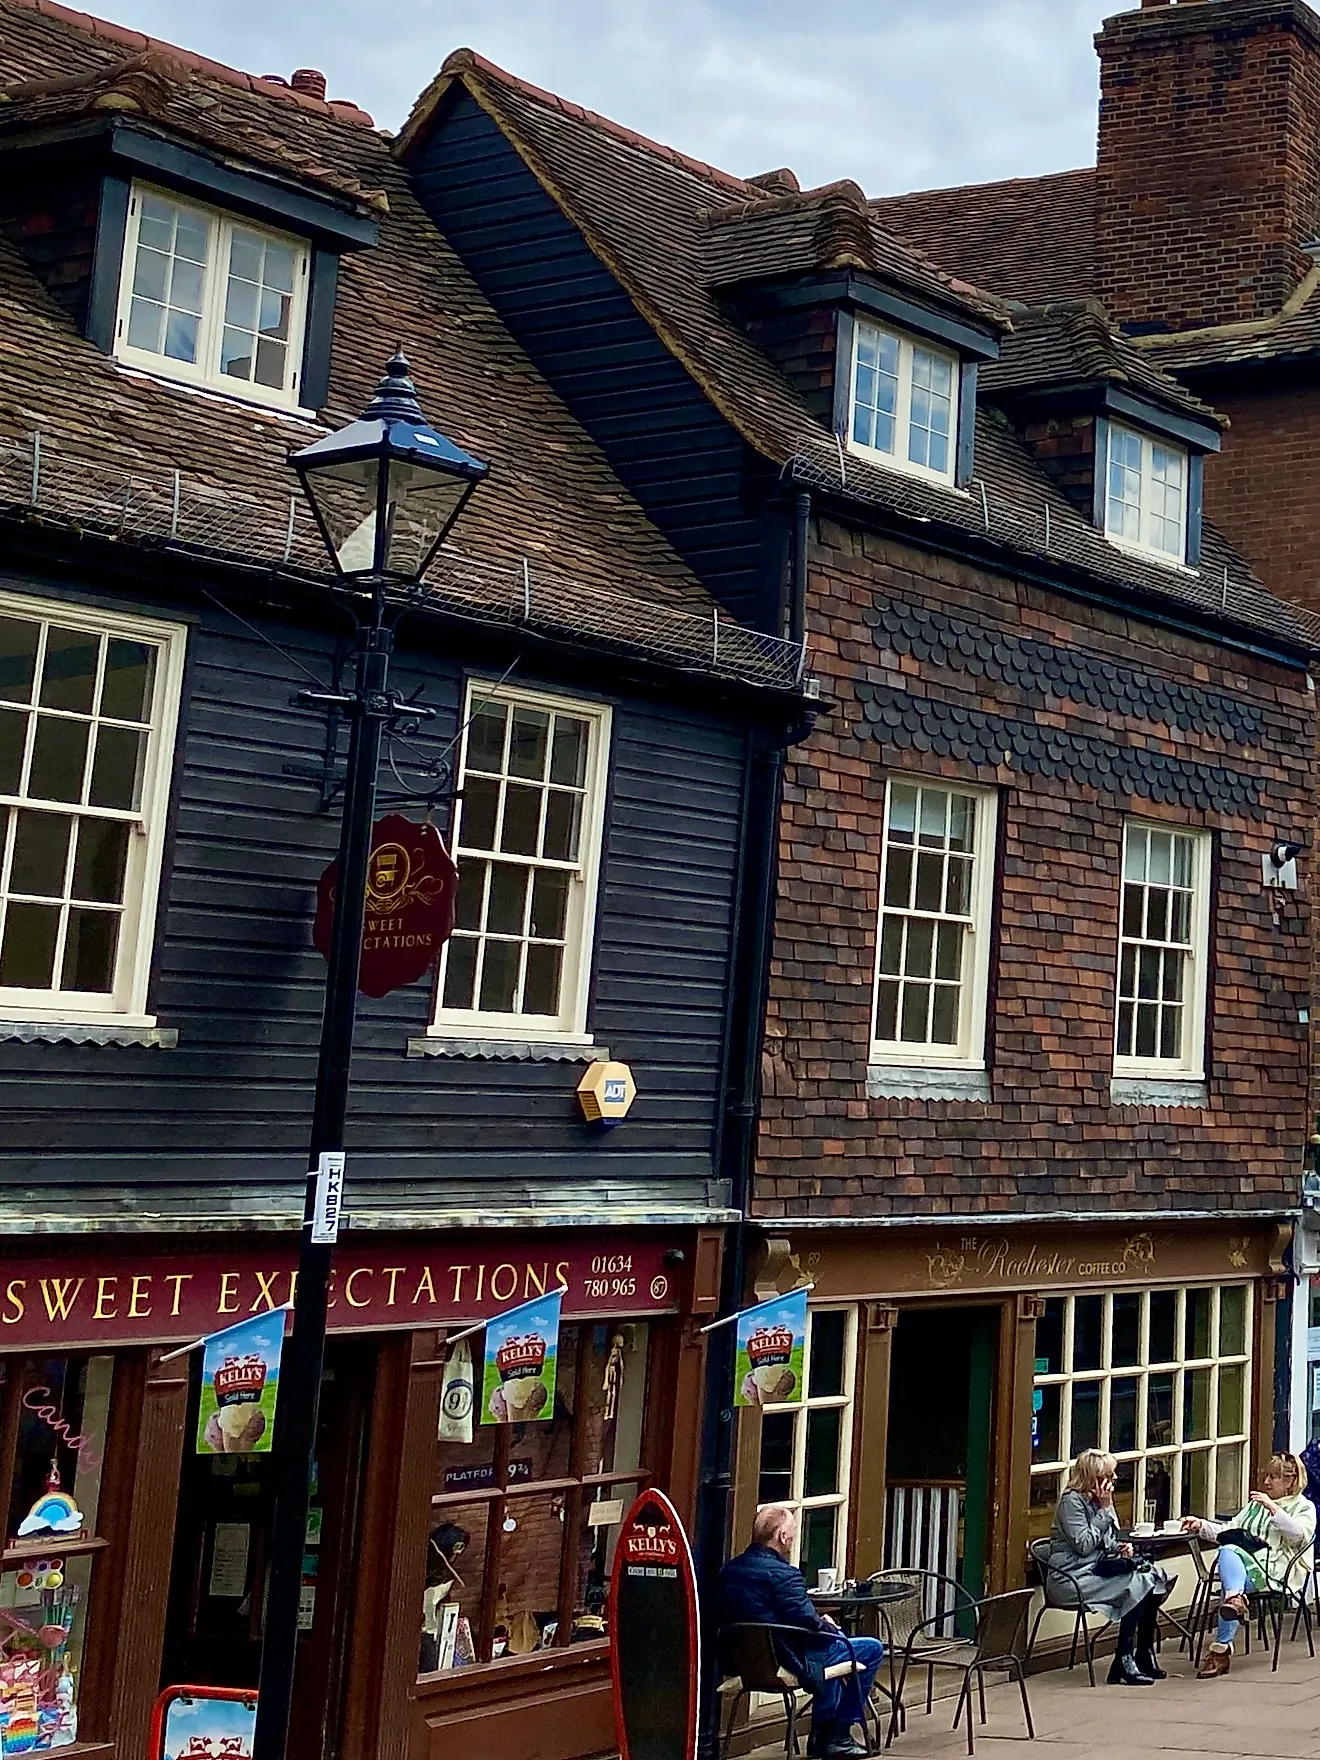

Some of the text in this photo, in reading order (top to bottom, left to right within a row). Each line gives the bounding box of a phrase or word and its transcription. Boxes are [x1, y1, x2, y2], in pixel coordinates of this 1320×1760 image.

[362, 917, 405, 932] WEET
[363, 933, 433, 951] CTATIONS
[604, 1084, 626, 1099] ADT
[325, 1168, 341, 1231] HKB27
[592, 1254, 633, 1273] 01634
[960, 1237, 977, 1251] THE
[976, 1238, 1076, 1278] Rochester
[1078, 1261, 1111, 1275] COFFEE
[2, 1260, 572, 1324] SWEET EXCTATIONS
[584, 1276, 665, 1298] 780 965 87
[751, 1334, 790, 1351] KELLY'S
[501, 1344, 543, 1364] KELLY'S
[219, 1366, 263, 1387] KELLY'S
[445, 1466, 494, 1482] PLATFO
[627, 1537, 677, 1555] KELLY'S
